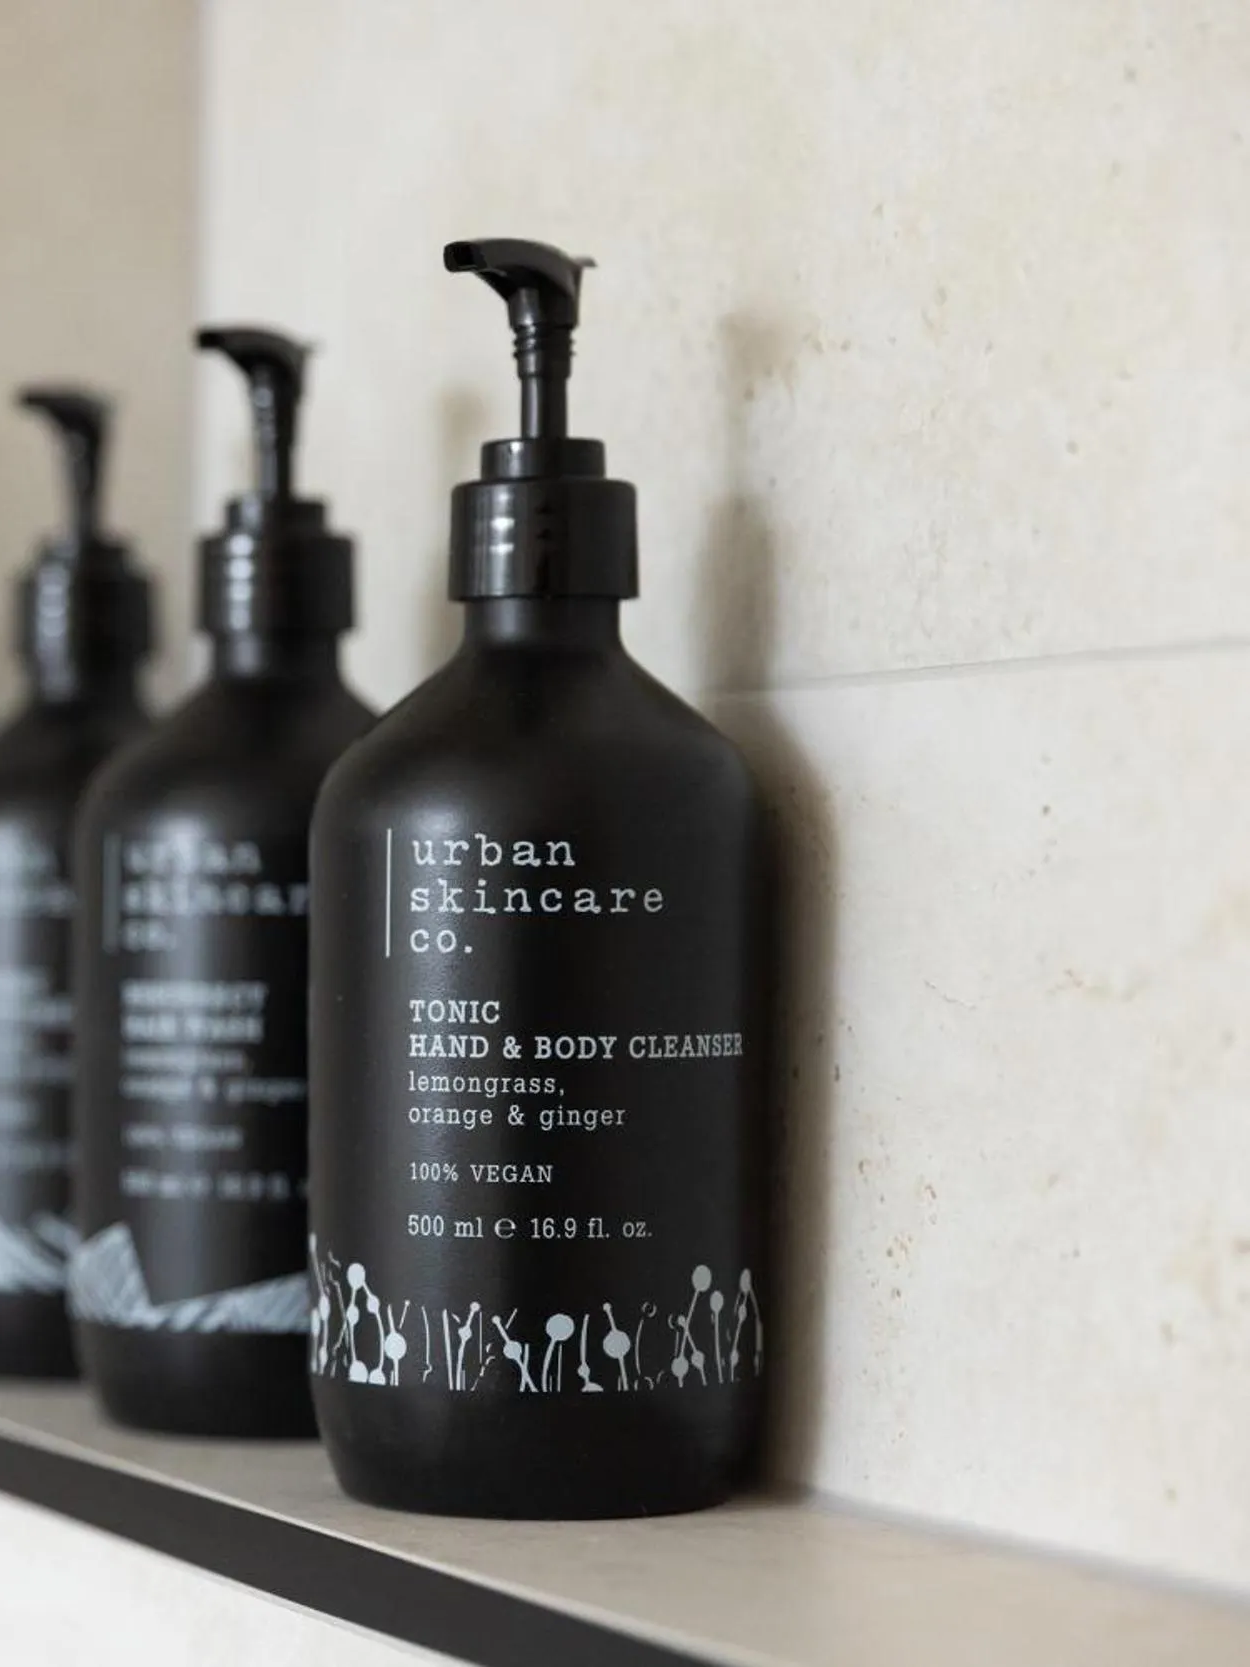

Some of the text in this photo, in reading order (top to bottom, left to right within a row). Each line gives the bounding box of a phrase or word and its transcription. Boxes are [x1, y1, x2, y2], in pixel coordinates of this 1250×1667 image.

[412, 833, 575, 867] urban
[410, 879, 663, 914] skincare
[410, 928, 472, 953] co.
[409, 1000, 500, 1024] TONIC
[409, 1033, 743, 1059] HAND & BODY CLEANSER
[408, 1071, 564, 1097] lemongrass,
[408, 1105, 626, 1131] orange & ginger
[410, 1162, 553, 1183] 100% VEGAN
[407, 1214, 445, 1237] 500
[453, 1216, 484, 1238] ml
[530, 1217, 577, 1239] 16.9
[587, 1217, 610, 1239] fl.
[622, 1221, 653, 1238] oz.
